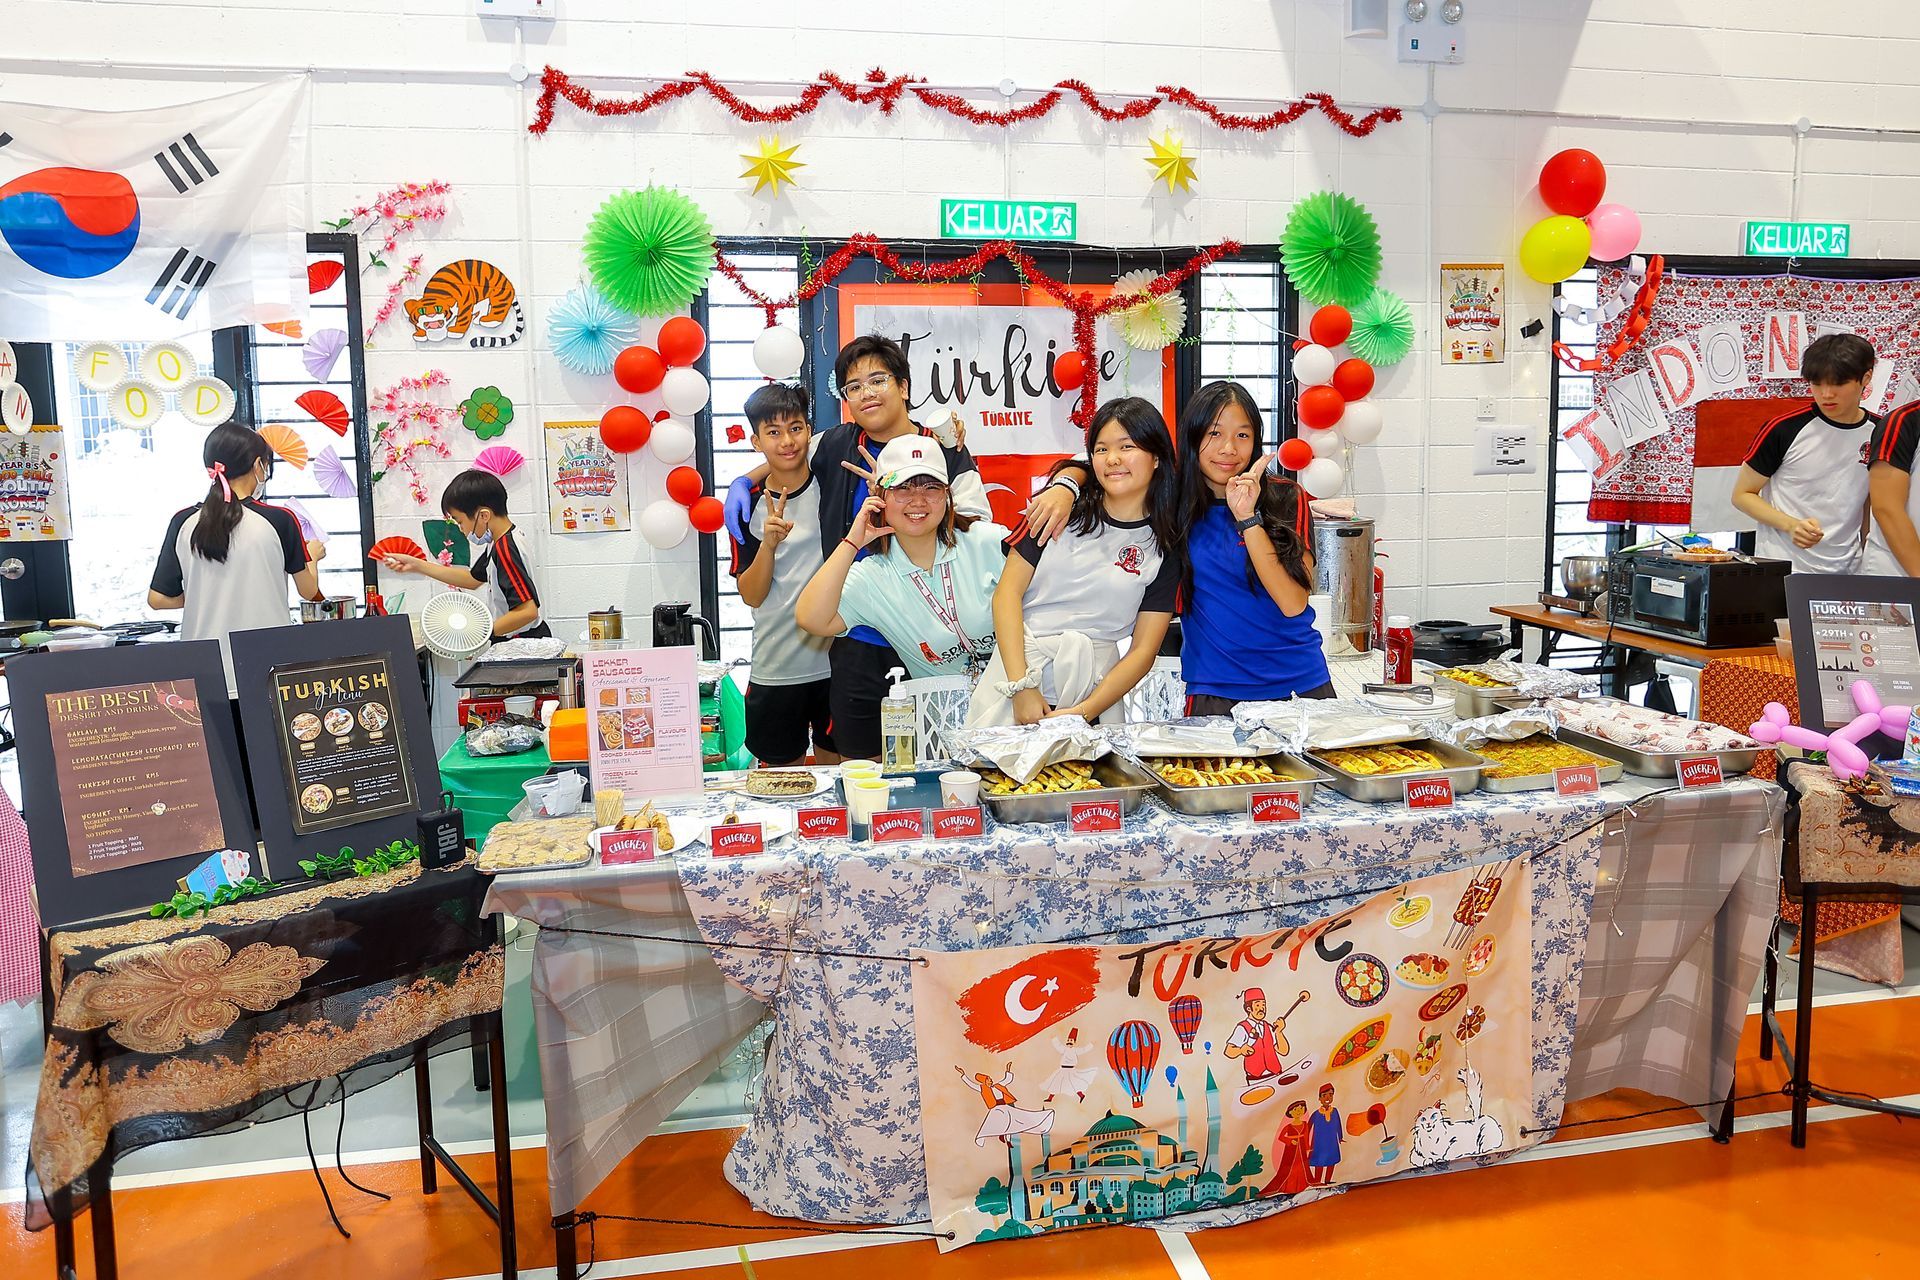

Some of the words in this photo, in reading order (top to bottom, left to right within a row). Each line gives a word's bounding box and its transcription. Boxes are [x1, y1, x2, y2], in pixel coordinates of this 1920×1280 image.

[945, 203, 1045, 236] KELUAR
[1749, 227, 1827, 254] KELUAR
[0, 461, 24, 469] YEAR
[569, 460, 591, 468] YEAR
[558, 468, 584, 479] FOOD
[553, 477, 618, 498] TURKEY
[1821, 629, 1847, 638] 29TH
[592, 658, 628, 668] LEKKER
[592, 667, 643, 678] SAUSAGES
[279, 672, 387, 701] TURKISH
[52, 695, 97, 714] THE
[100, 689, 151, 708] BEST
[59, 710, 102, 722] DESSERT
[104, 707, 126, 717] AND
[126, 704, 159, 714] DRINKS
[1683, 763, 1719, 779] CHICKEN
[78, 779, 111, 790] TURKISH
[112, 775, 136, 784] COFFEE
[1561, 773, 1592, 787] BAKLAVA
[1409, 785, 1450, 800] CHICKEN
[1253, 797, 1300, 815] BEEF&LAMB
[803, 816, 840, 829] YOGURT
[939, 815, 976, 829] TURKISH
[1072, 807, 1119, 824] VEGETABLE
[875, 818, 920, 835] LIMONATA
[104, 839, 125, 847] Topping
[437, 823, 459, 860] JBL
[608, 840, 649, 854] CHICKEN
[719, 833, 757, 847] CHICKEN
[93, 852, 105, 860] Fruit
